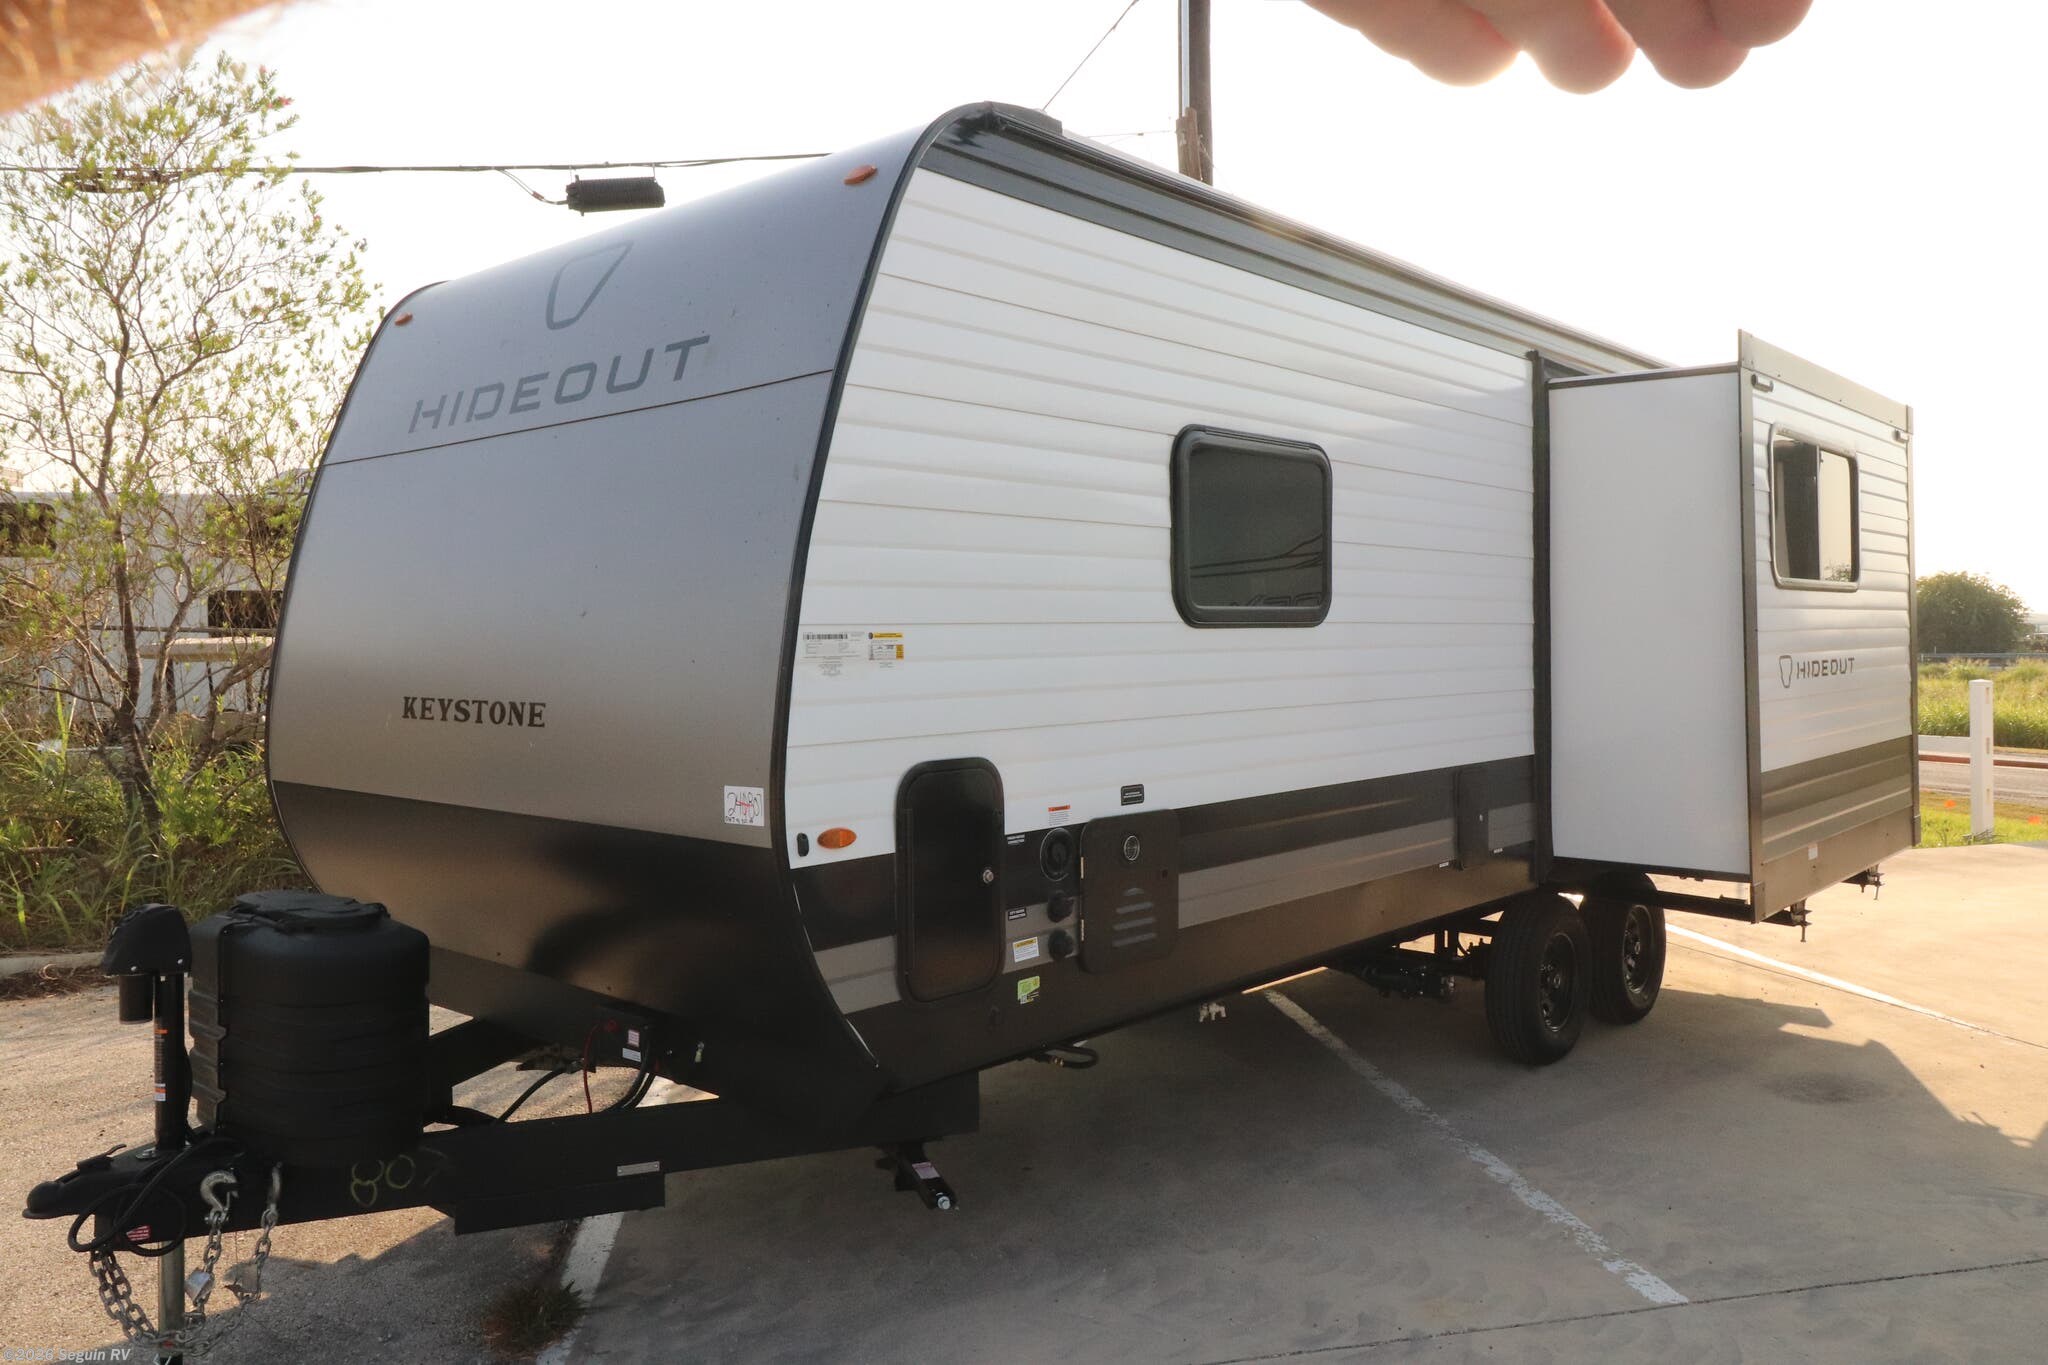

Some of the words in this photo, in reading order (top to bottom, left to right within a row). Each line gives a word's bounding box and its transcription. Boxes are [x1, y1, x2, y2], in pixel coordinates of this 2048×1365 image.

[408, 335, 710, 434] HIDEOUT
[1796, 657, 1855, 679] HIDEOUT
[401, 696, 546, 728] KEYSTONE
